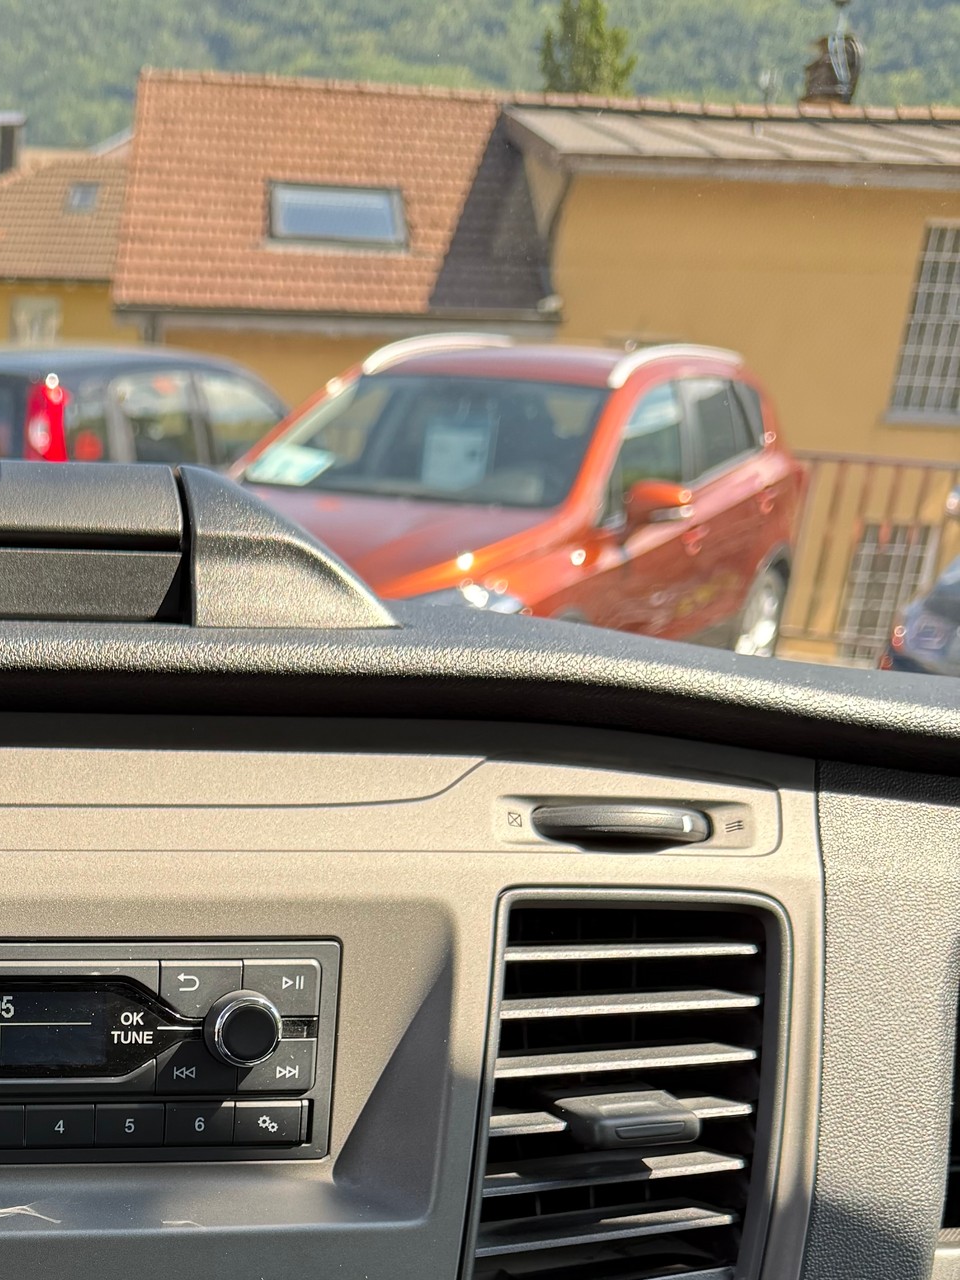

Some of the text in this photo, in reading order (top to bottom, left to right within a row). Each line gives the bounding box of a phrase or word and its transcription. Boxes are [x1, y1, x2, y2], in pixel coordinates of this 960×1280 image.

[120, 1011, 144, 1026] OK
[111, 1031, 154, 1044] TUNE
[54, 1119, 65, 1134] 4
[124, 1118, 135, 1133] 5
[194, 1117, 205, 1132] 6
